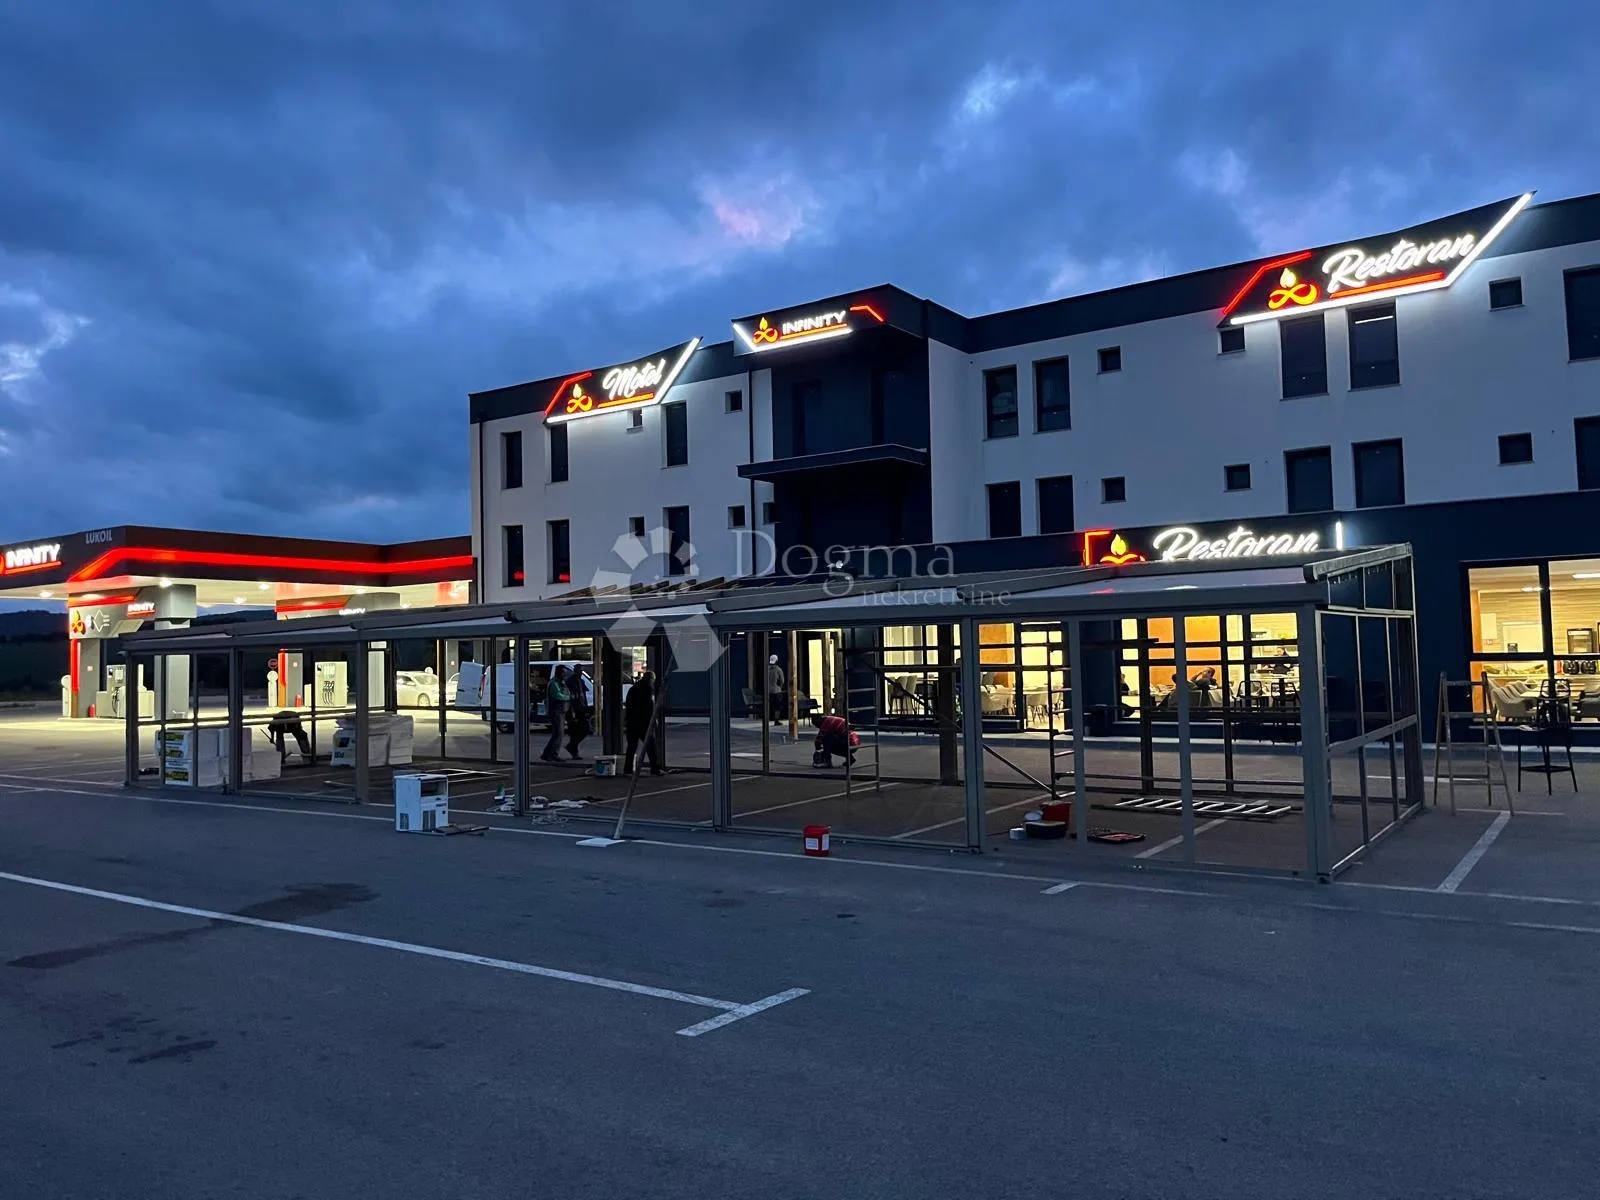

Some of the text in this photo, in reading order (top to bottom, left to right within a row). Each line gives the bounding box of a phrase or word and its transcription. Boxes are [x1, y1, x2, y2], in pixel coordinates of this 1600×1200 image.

[1322, 233, 1475, 294] Restoran
[782, 310, 846, 335] INFINITY
[602, 358, 666, 400] Motel
[85, 529, 113, 544] LUKOIL
[1152, 526, 1319, 561] Restoran
